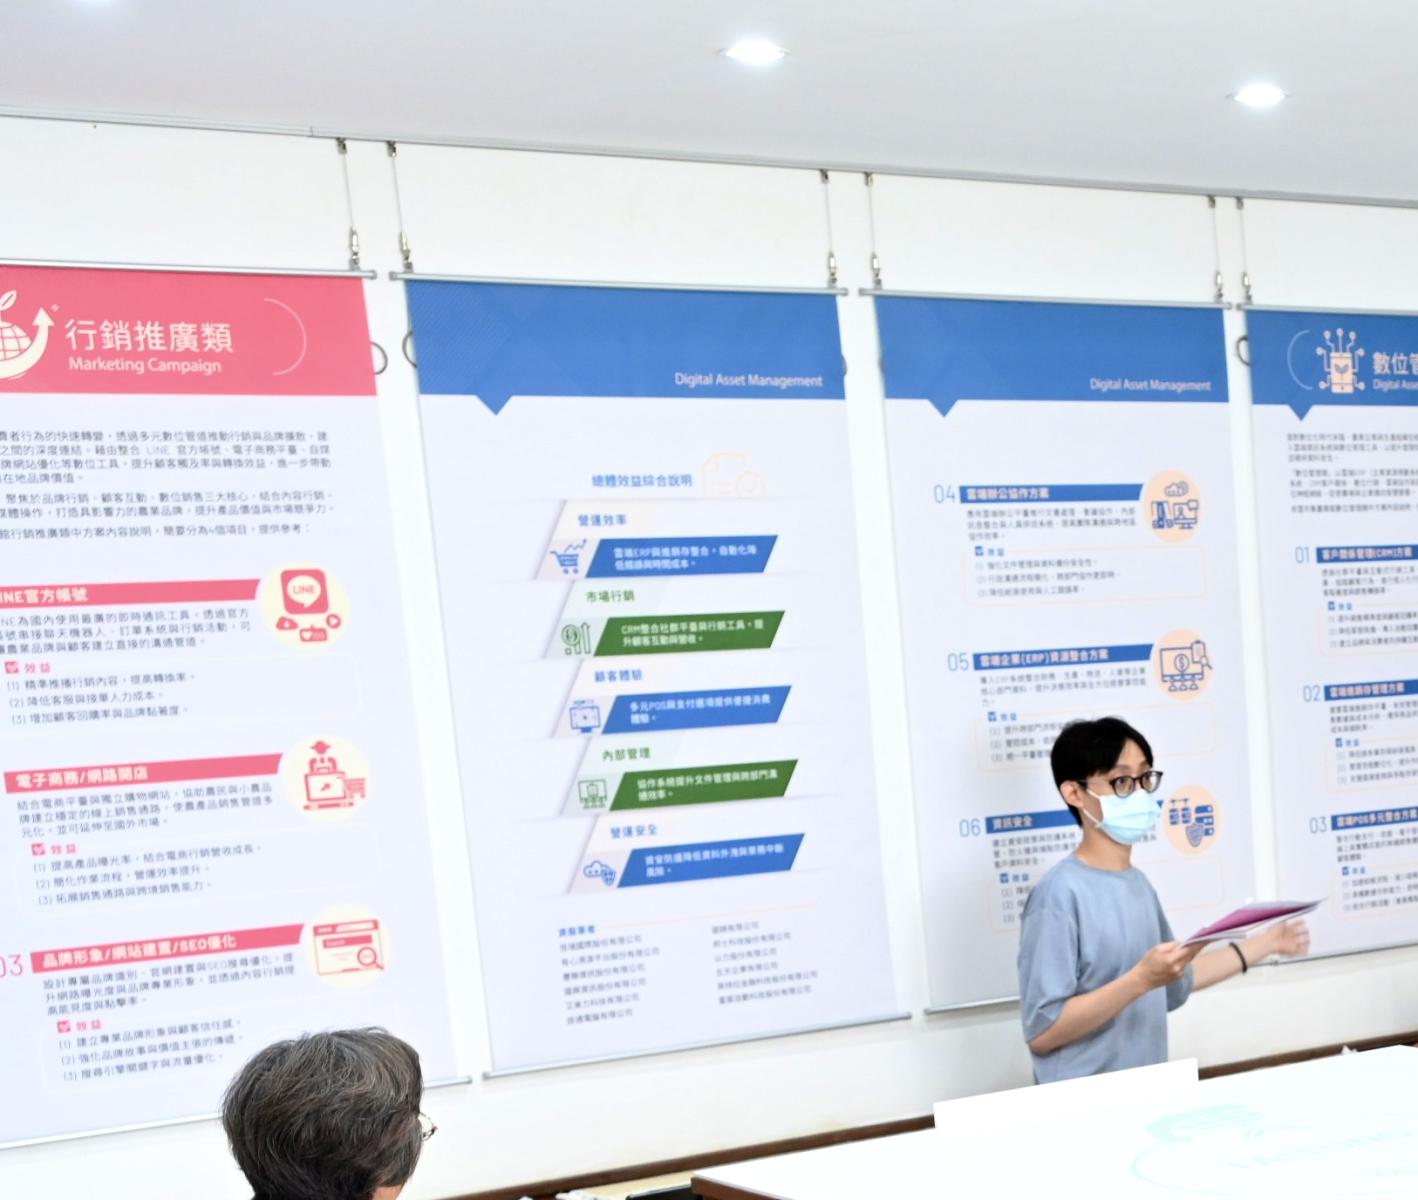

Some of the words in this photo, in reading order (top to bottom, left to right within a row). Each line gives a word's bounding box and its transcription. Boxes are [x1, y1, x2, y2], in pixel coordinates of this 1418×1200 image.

[65, 320, 234, 354] 行銷推廣類
[148, 358, 221, 375] Campaign
[675, 373, 712, 385] Digital
[716, 373, 745, 385] Asset
[1090, 379, 1121, 392] Digital
[1124, 379, 1148, 390] Asset
[1373, 379, 1399, 391] Digital
[0, 473, 83, 484] 在地品牌價值。
[592, 474, 692, 487] 總體效益綜合說明
[934, 485, 956, 503] 04
[578, 514, 626, 527] 營運效率
[1295, 547, 1309, 563] 01
[293, 584, 315, 595] LINE
[586, 590, 635, 603] 市場行銷
[948, 653, 969, 671] 05
[594, 670, 643, 683] 顧客體驗
[1303, 685, 1320, 702] 02
[602, 748, 651, 761] 內部管理
[960, 819, 980, 837] 06
[1309, 817, 1327, 833] 03
[611, 825, 657, 839] 營運安全
